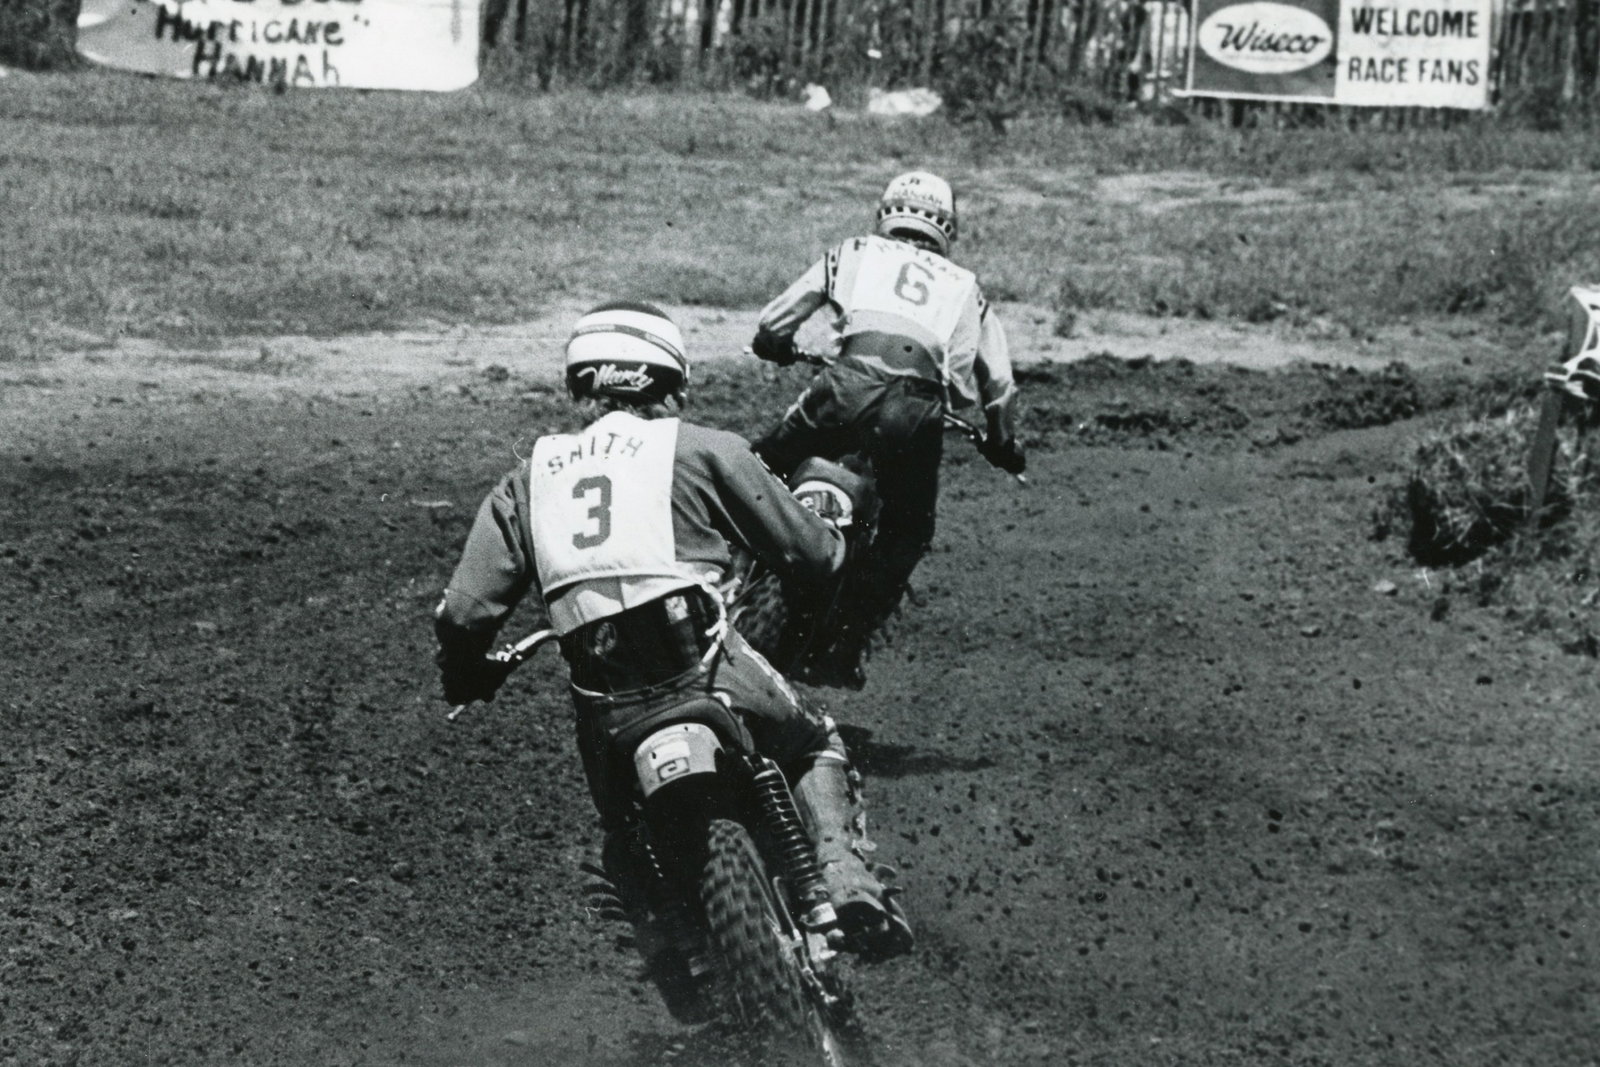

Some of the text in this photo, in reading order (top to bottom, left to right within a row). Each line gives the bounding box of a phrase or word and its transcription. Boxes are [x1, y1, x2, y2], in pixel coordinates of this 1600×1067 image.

[1215, 20, 1327, 54] Wiseco
[1351, 7, 1480, 39] WELCOME
[1348, 56, 1480, 86] RACE FANS
[894, 261, 930, 306] 6
[547, 432, 643, 475] SMITH
[572, 475, 612, 550] 3
